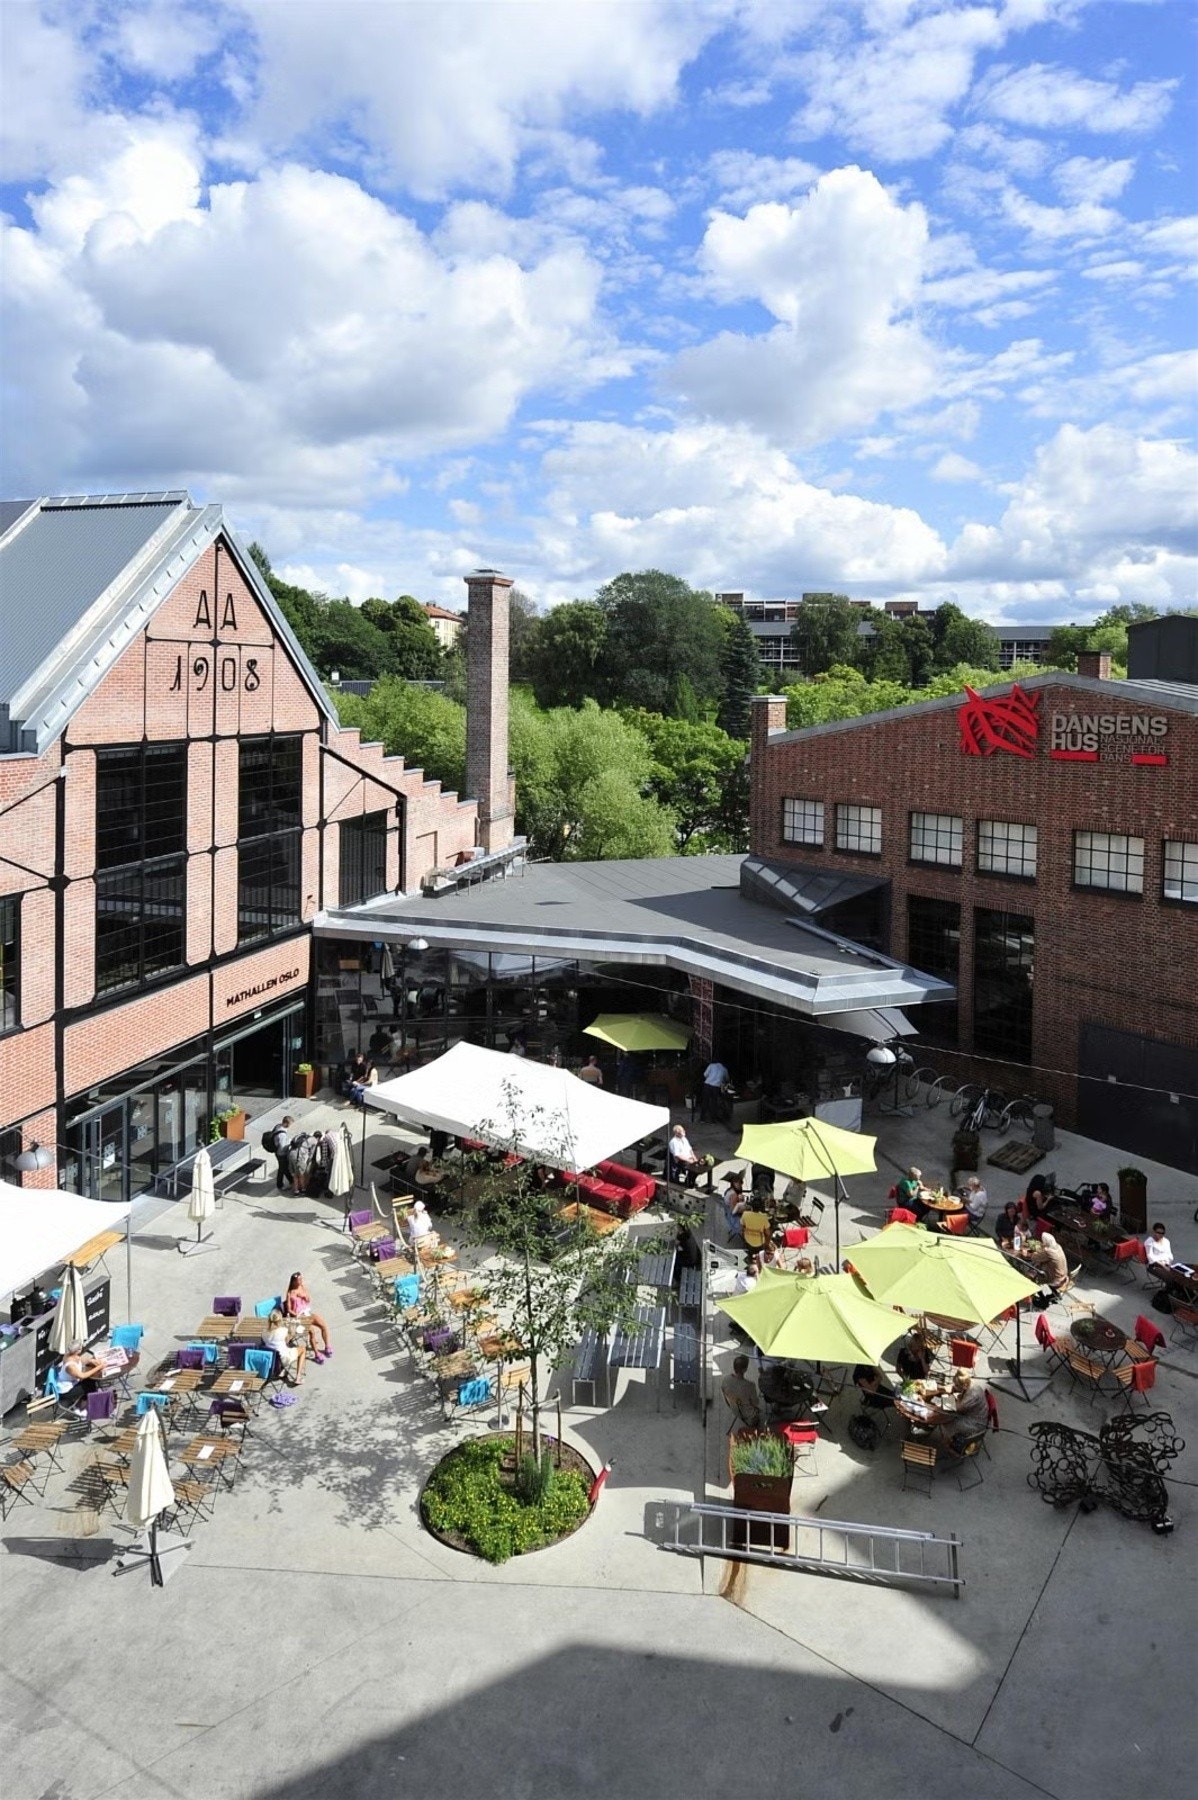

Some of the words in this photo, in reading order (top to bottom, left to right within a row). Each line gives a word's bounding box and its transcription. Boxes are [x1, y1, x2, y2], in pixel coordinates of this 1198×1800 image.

[169, 655, 260, 691] 1908
[1052, 714, 1168, 736] DANSENS
[1051, 733, 1099, 752] HUS
[1100, 744, 1137, 754] SCENE
[1140, 745, 1165, 755] FOR
[1100, 753, 1132, 762] DANS
[226, 977, 278, 1007] MATHALLEN
[279, 968, 300, 984] OSLO
